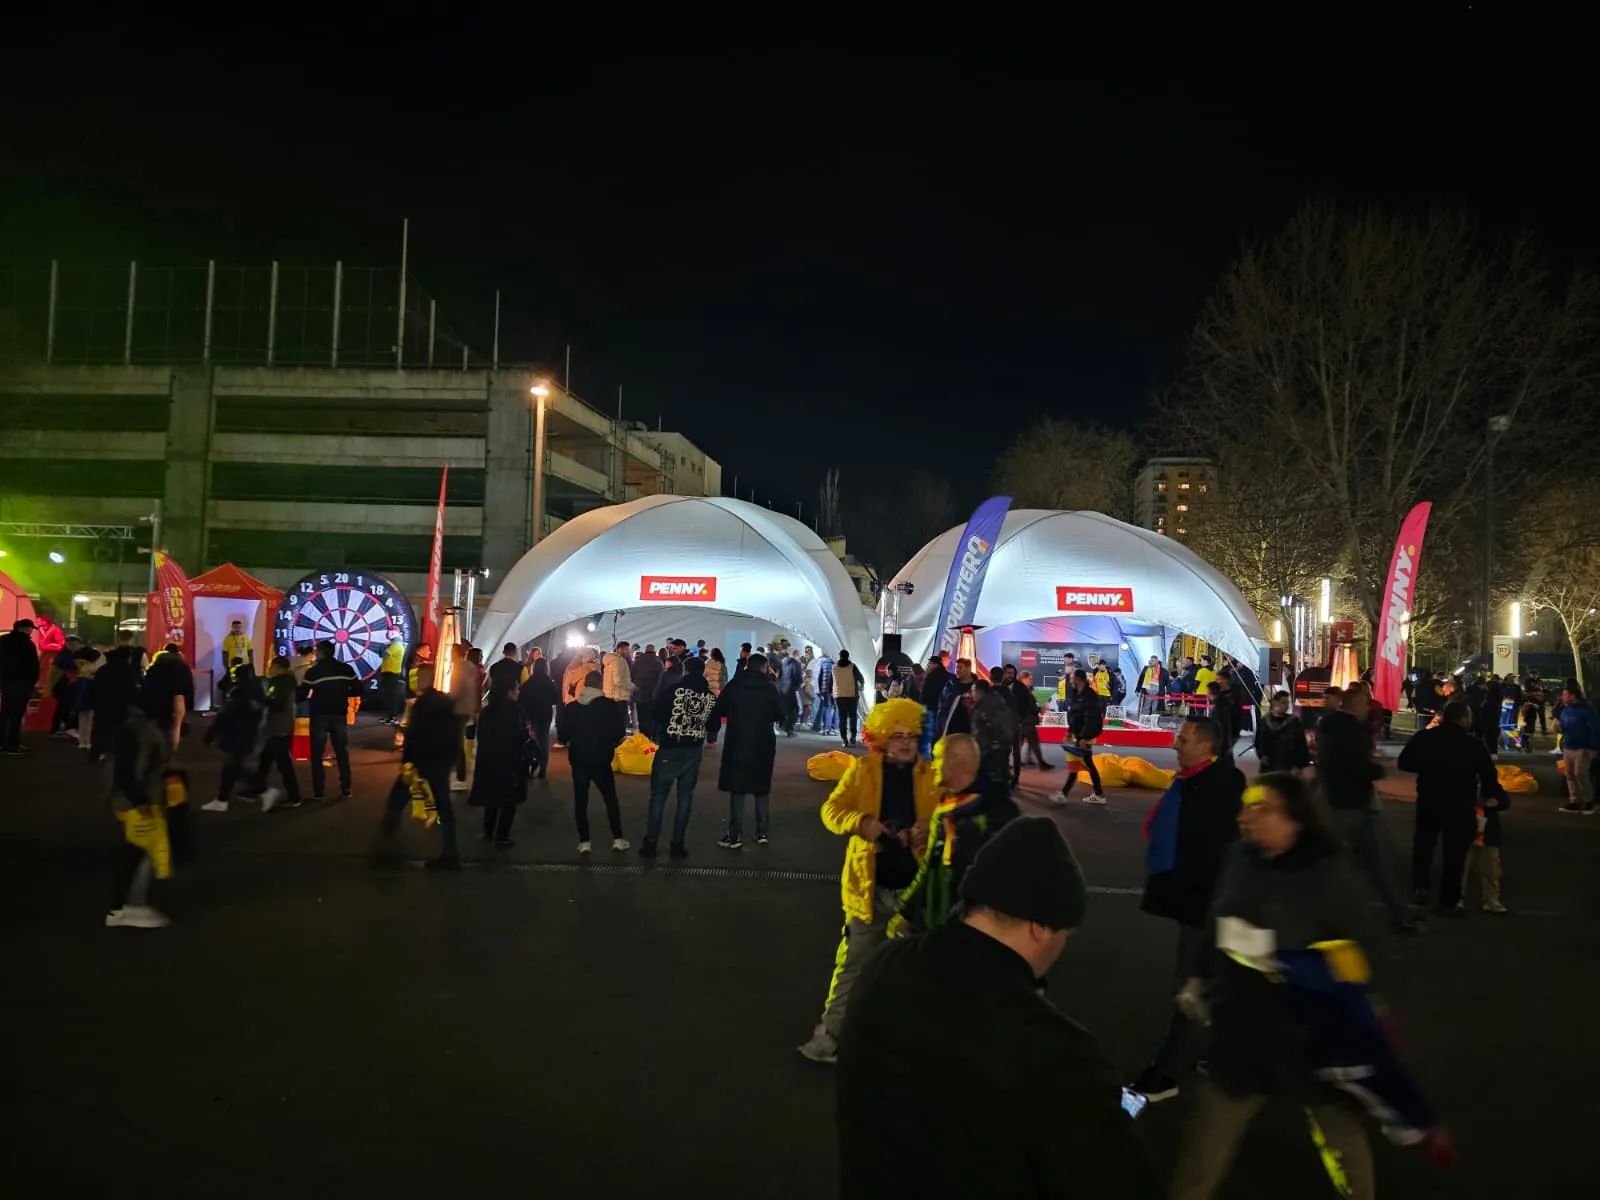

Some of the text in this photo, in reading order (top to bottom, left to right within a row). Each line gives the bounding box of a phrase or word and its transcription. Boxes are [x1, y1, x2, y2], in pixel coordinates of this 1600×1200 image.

[320, 575, 329, 585] 5
[335, 573, 349, 583] 20
[357, 576, 363, 586] 1
[300, 583, 314, 593] 12
[370, 585, 384, 595] 18
[289, 595, 298, 605] 9
[385, 597, 393, 607] 4
[279, 610, 292, 620] 14
[391, 615, 404, 625] 13
[275, 629, 287, 638] 11
[279, 646, 287, 656] 8
[370, 679, 378, 689] 2
